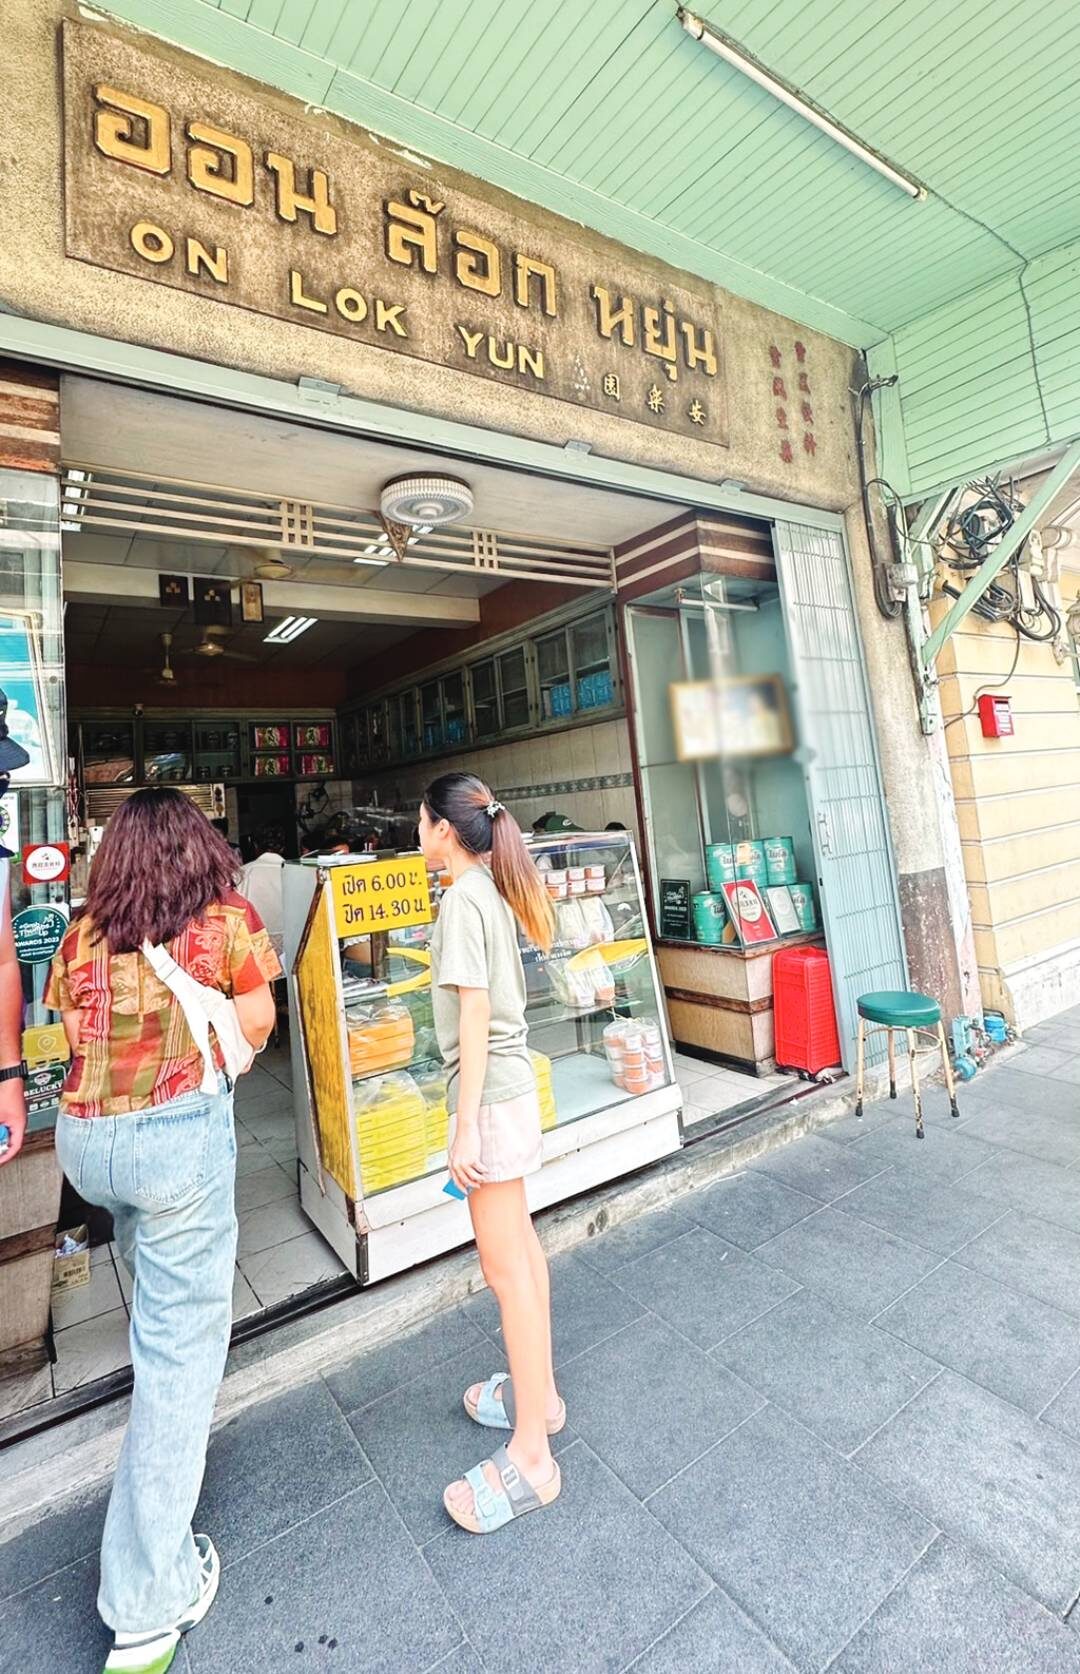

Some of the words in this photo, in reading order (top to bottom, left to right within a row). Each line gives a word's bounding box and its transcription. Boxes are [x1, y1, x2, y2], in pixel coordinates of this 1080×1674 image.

[96, 84, 337, 235] ออน
[593, 286, 717, 382] หยุ่น
[130, 221, 229, 284] ON
[291, 270, 407, 338] LOK
[458, 326, 544, 379] YUN
[342, 903, 365, 924] ปิด
[369, 898, 411, 921] 14.30
[371, 872, 406, 892] 6.00
